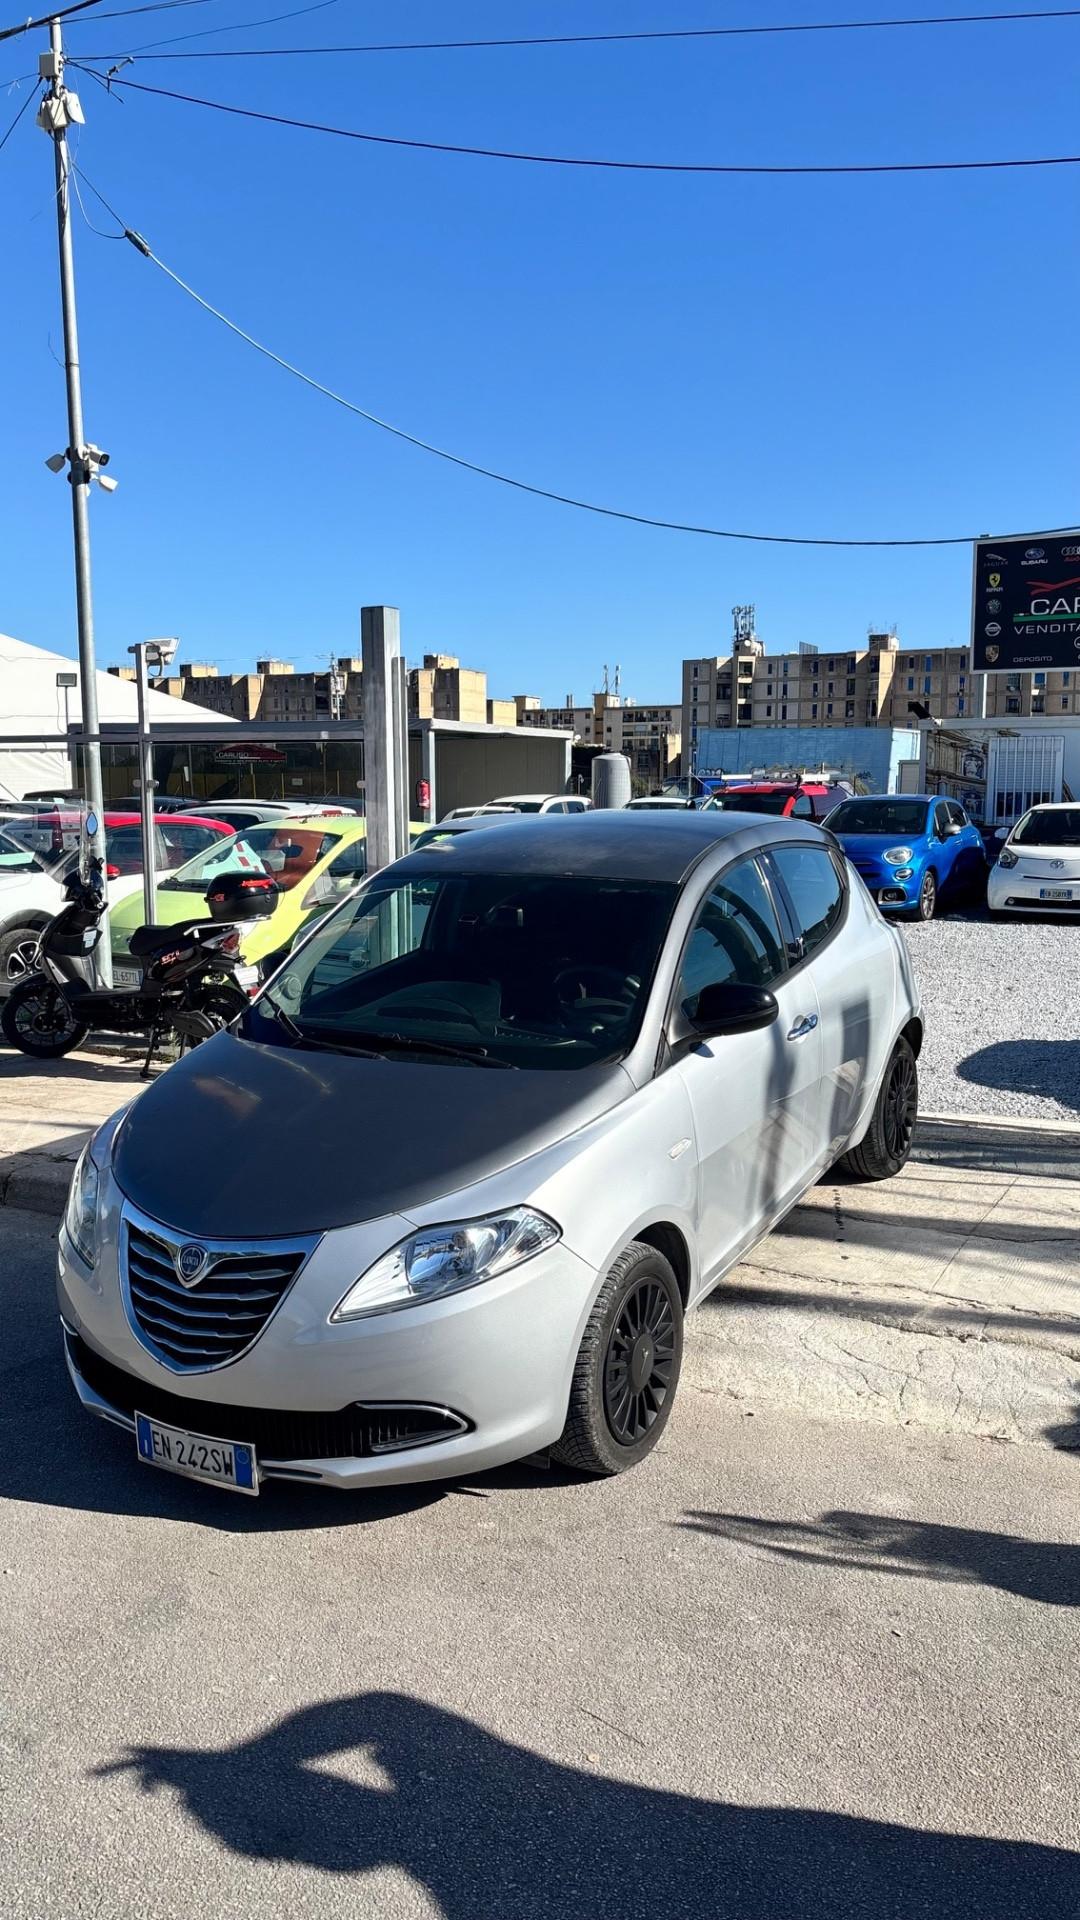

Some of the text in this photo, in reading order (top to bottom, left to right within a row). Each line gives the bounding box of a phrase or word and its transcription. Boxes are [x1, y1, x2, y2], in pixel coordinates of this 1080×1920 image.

[1012, 655, 1053, 663] DEPOSITO
[218, 751, 249, 759] CARUSO
[152, 1430, 233, 1477] EN 242SW
